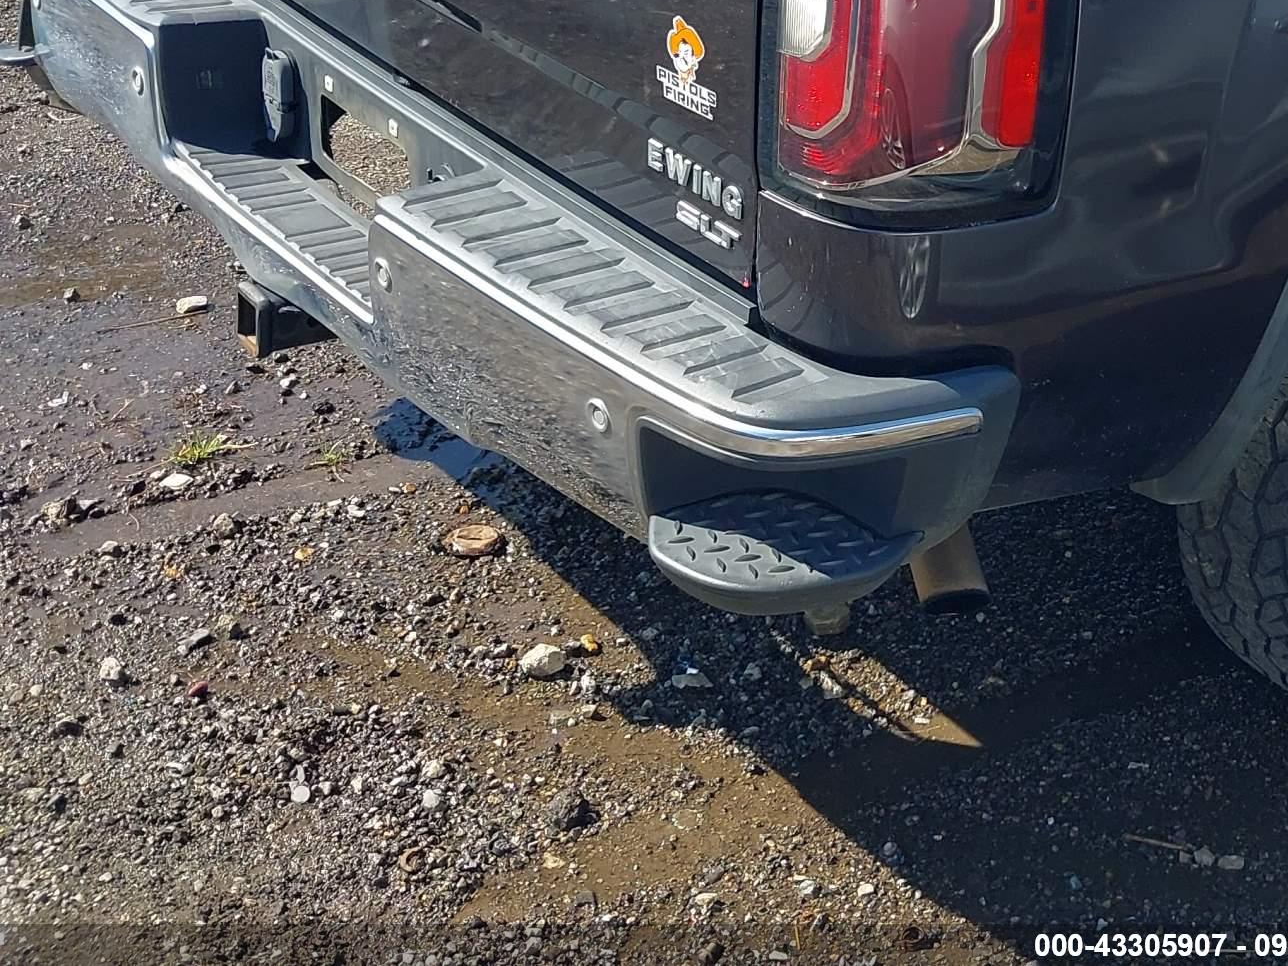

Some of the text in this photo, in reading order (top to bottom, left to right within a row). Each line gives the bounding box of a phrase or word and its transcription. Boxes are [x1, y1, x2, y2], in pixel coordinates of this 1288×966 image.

[665, 85, 710, 116] FIRING
[648, 138, 743, 220] EWING
[676, 200, 743, 250] SLT
